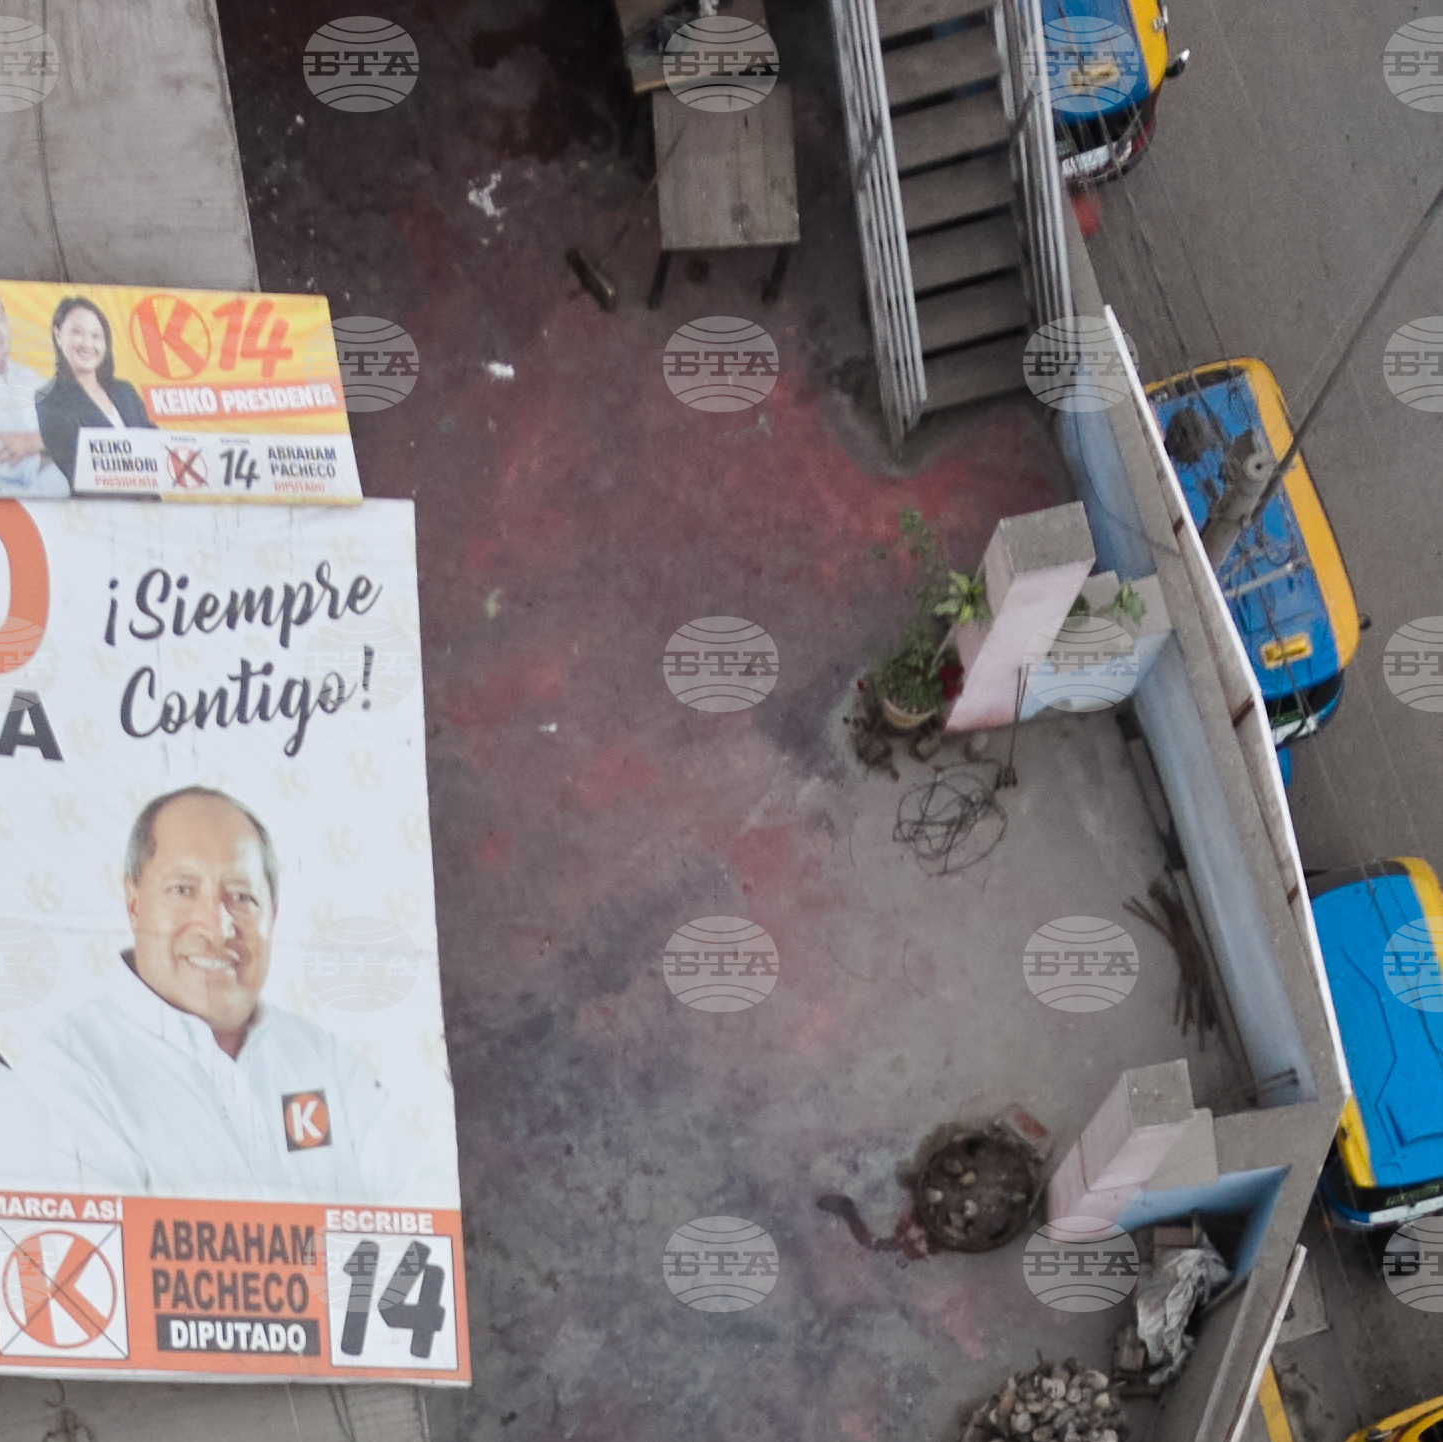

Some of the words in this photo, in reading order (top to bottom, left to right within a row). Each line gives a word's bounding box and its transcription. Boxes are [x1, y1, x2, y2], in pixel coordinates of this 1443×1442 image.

[135, 294, 210, 380] K
[213, 298, 293, 378] 14
[151, 385, 217, 415] KEIKO
[222, 382, 337, 413] PRESIDENTA
[89, 439, 132, 454] KEIKO
[268, 445, 337, 461] ABRAHAM
[219, 448, 261, 490] 14
[270, 462, 336, 479] PACHECO
[104, 560, 384, 649] ¡Siempre
[119, 643, 375, 757] Contigo!
[291, 1099, 324, 1142] K
[149, 1219, 316, 1266] ABRAHAM
[325, 1209, 434, 1235] ESCRIBE
[152, 1267, 311, 1314] PACHECO
[339, 1239, 446, 1360] 14
[170, 1319, 307, 1353] DIPUTADO
